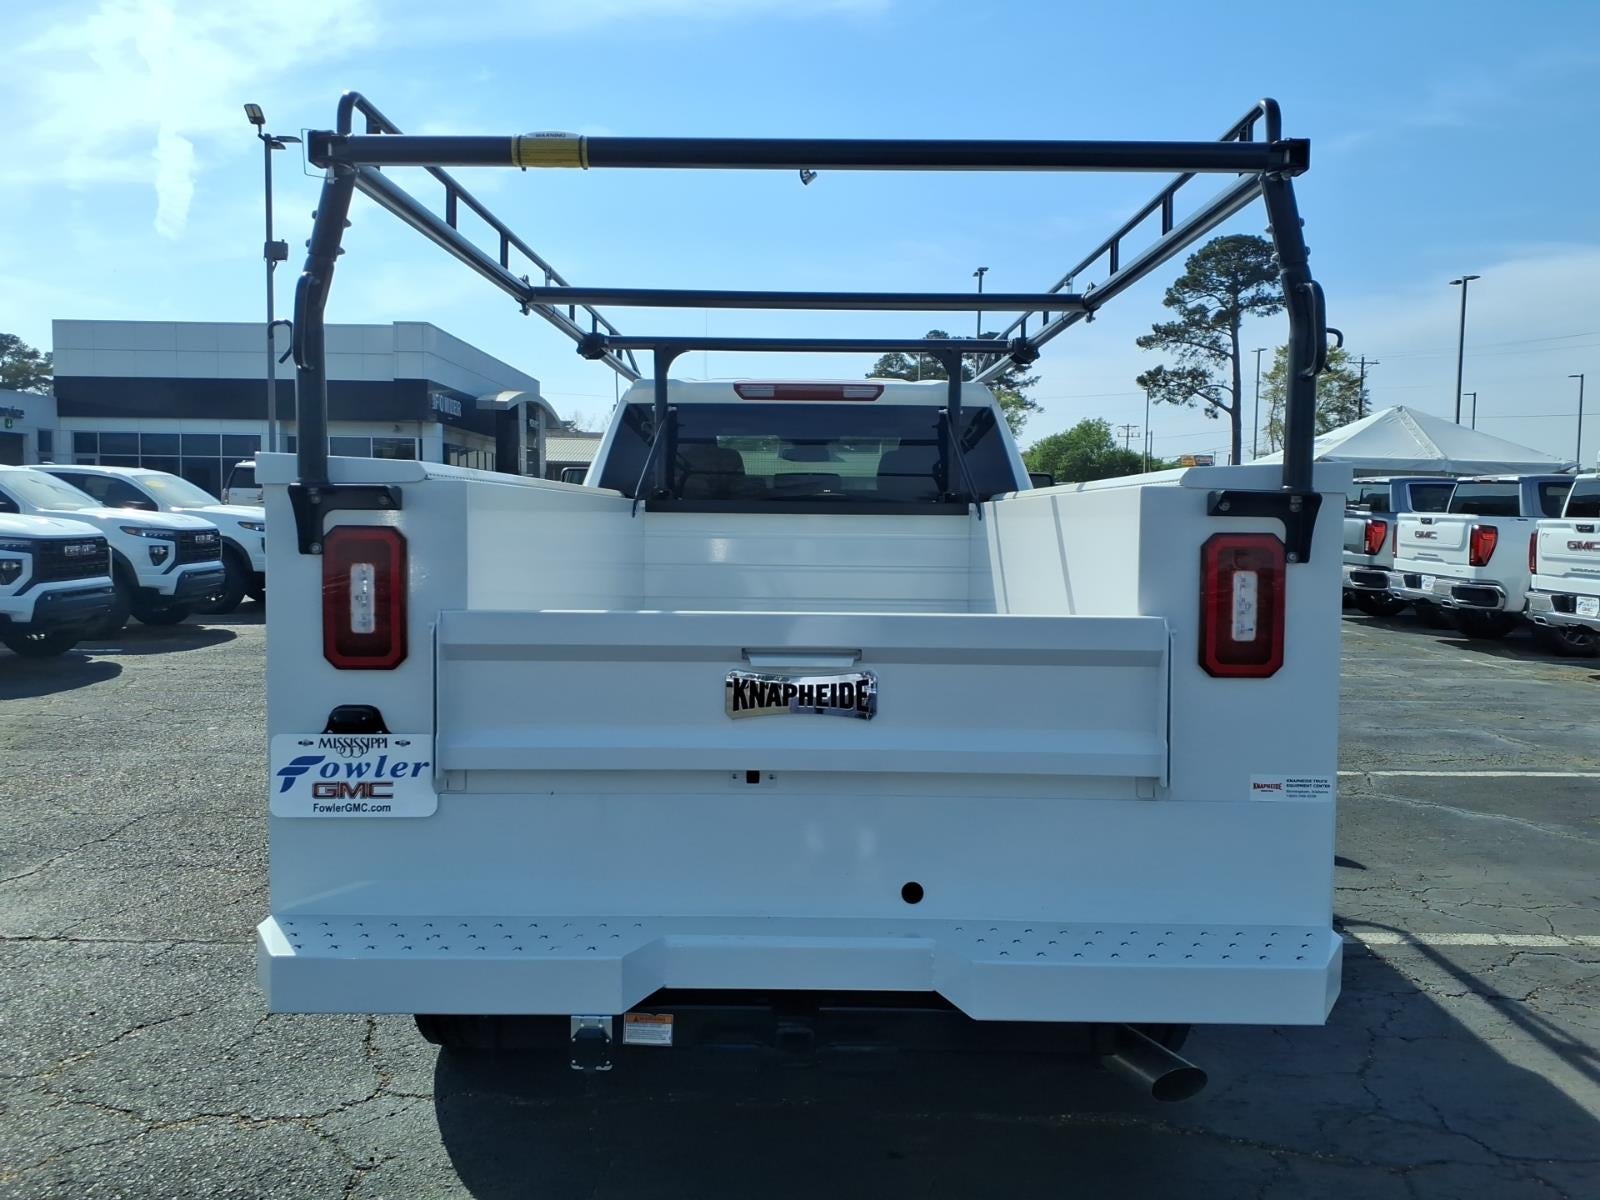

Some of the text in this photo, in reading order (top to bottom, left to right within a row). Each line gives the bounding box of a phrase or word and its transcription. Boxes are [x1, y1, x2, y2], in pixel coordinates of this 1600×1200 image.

[1415, 530, 1438, 540] GMC
[732, 677, 870, 712] KNAPHEIDE
[318, 737, 388, 758] MISSISSIPPI
[276, 755, 430, 793] Fowler
[312, 782, 394, 799] GMC
[312, 803, 392, 813] FowlerGMC.com
